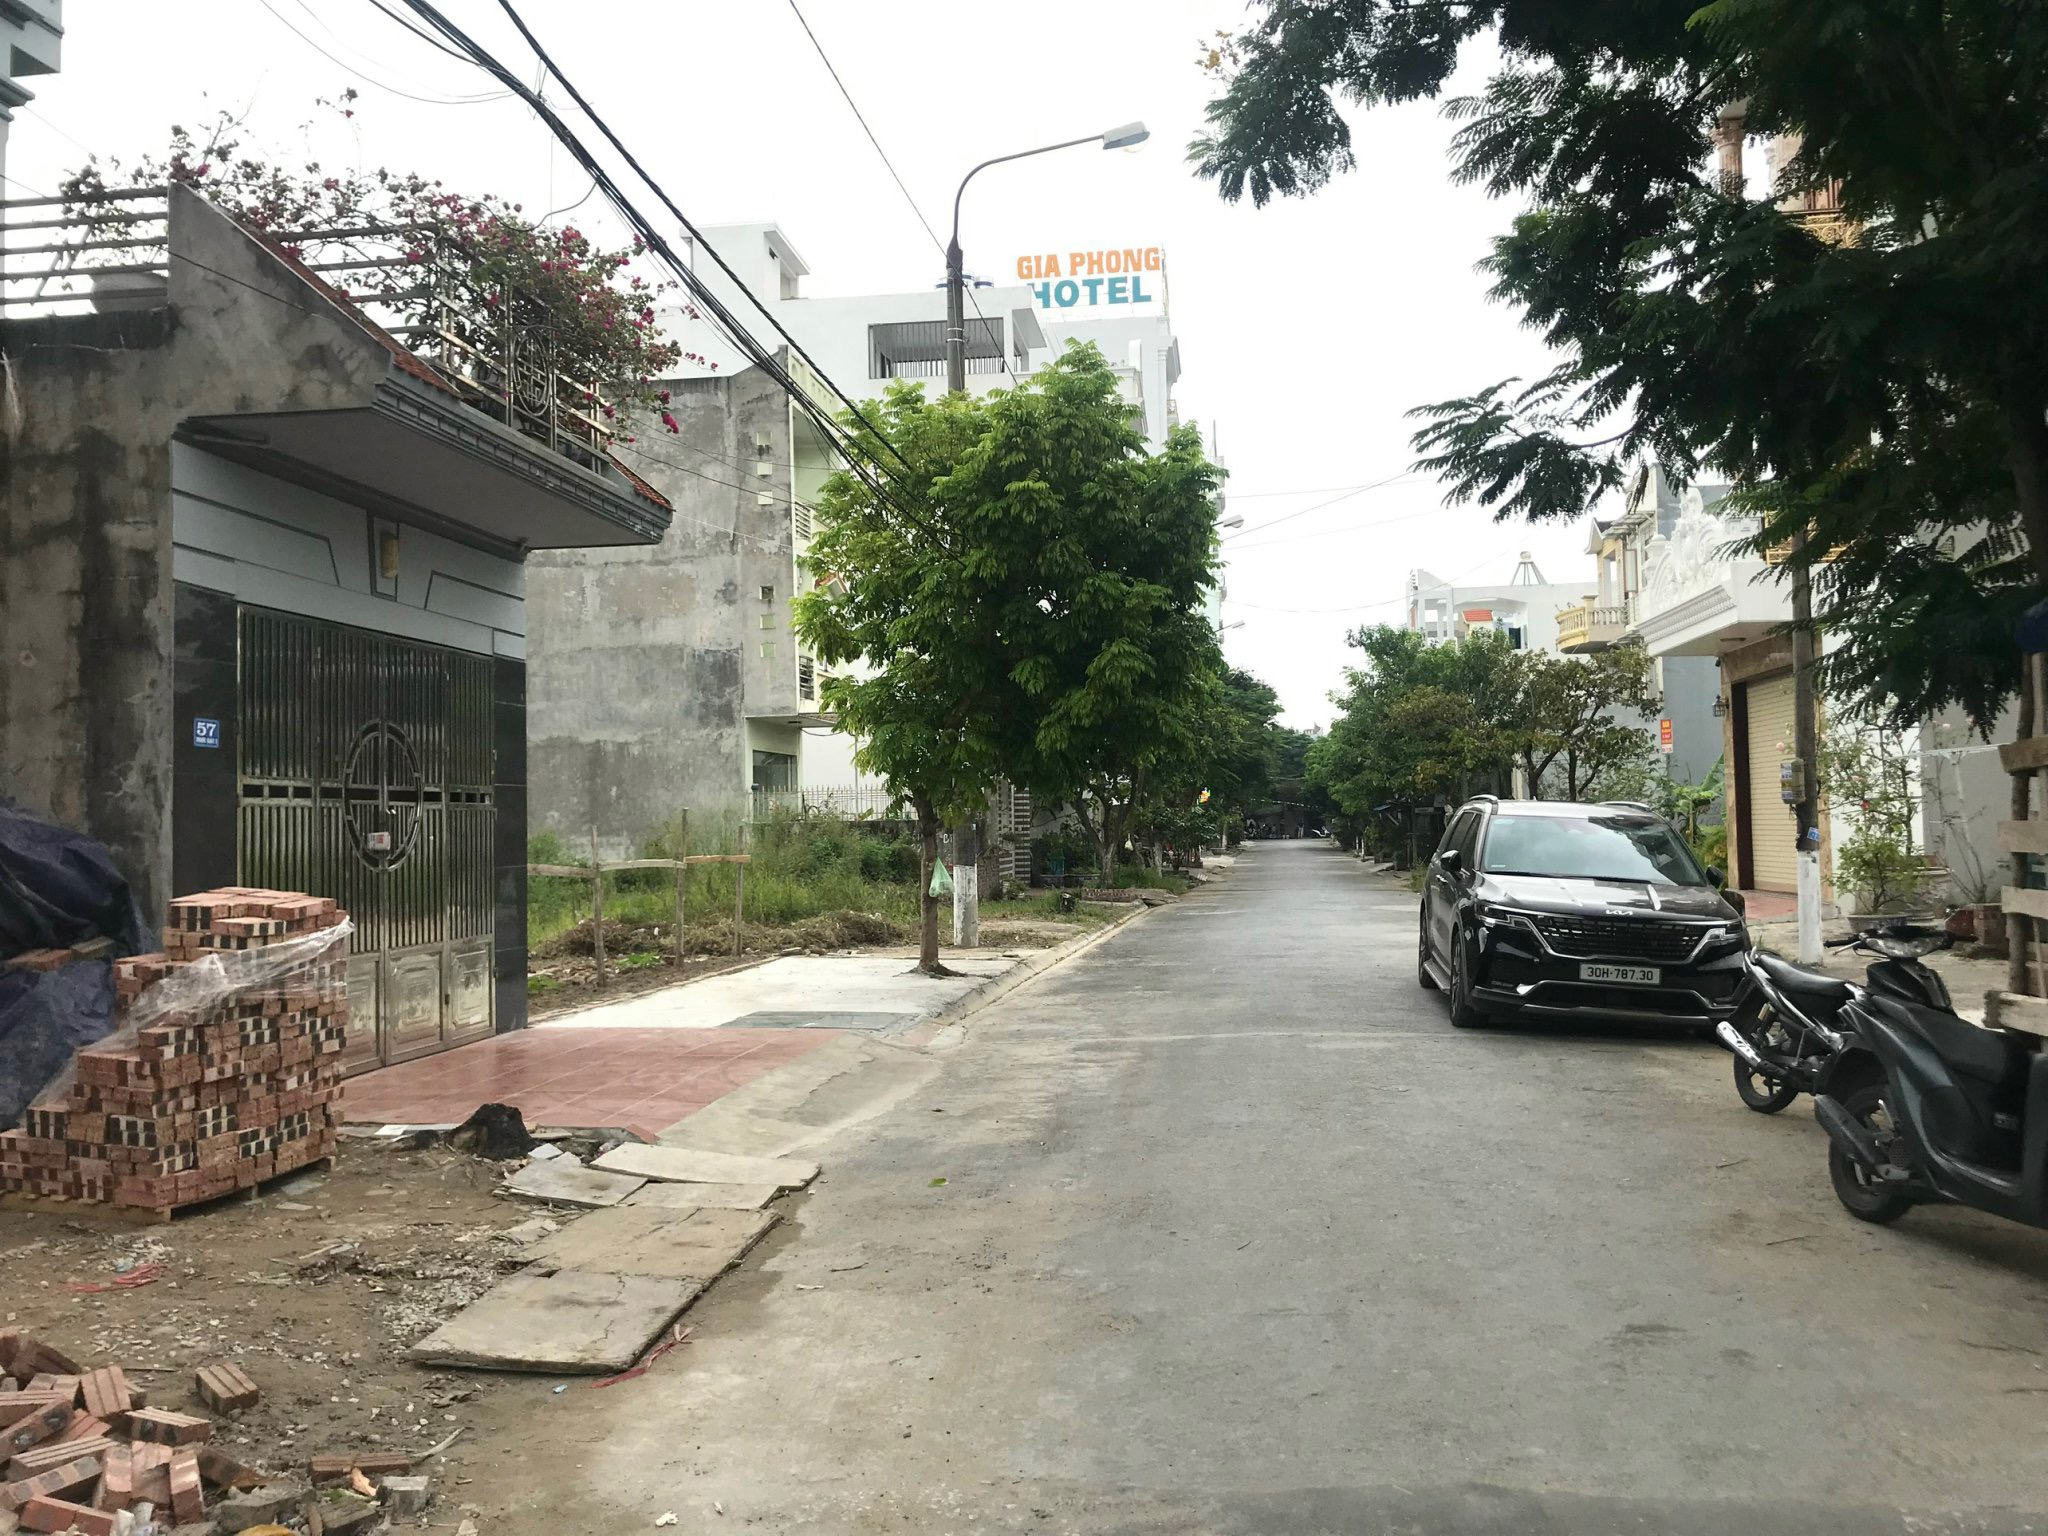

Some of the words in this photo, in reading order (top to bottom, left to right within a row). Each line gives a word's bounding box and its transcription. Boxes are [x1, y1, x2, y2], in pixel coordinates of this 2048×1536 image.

[1017, 253, 1061, 279] GIA
[1069, 247, 1160, 276] PHONG
[1027, 276, 1152, 308] HOTEL
[196, 721, 217, 737] 57
